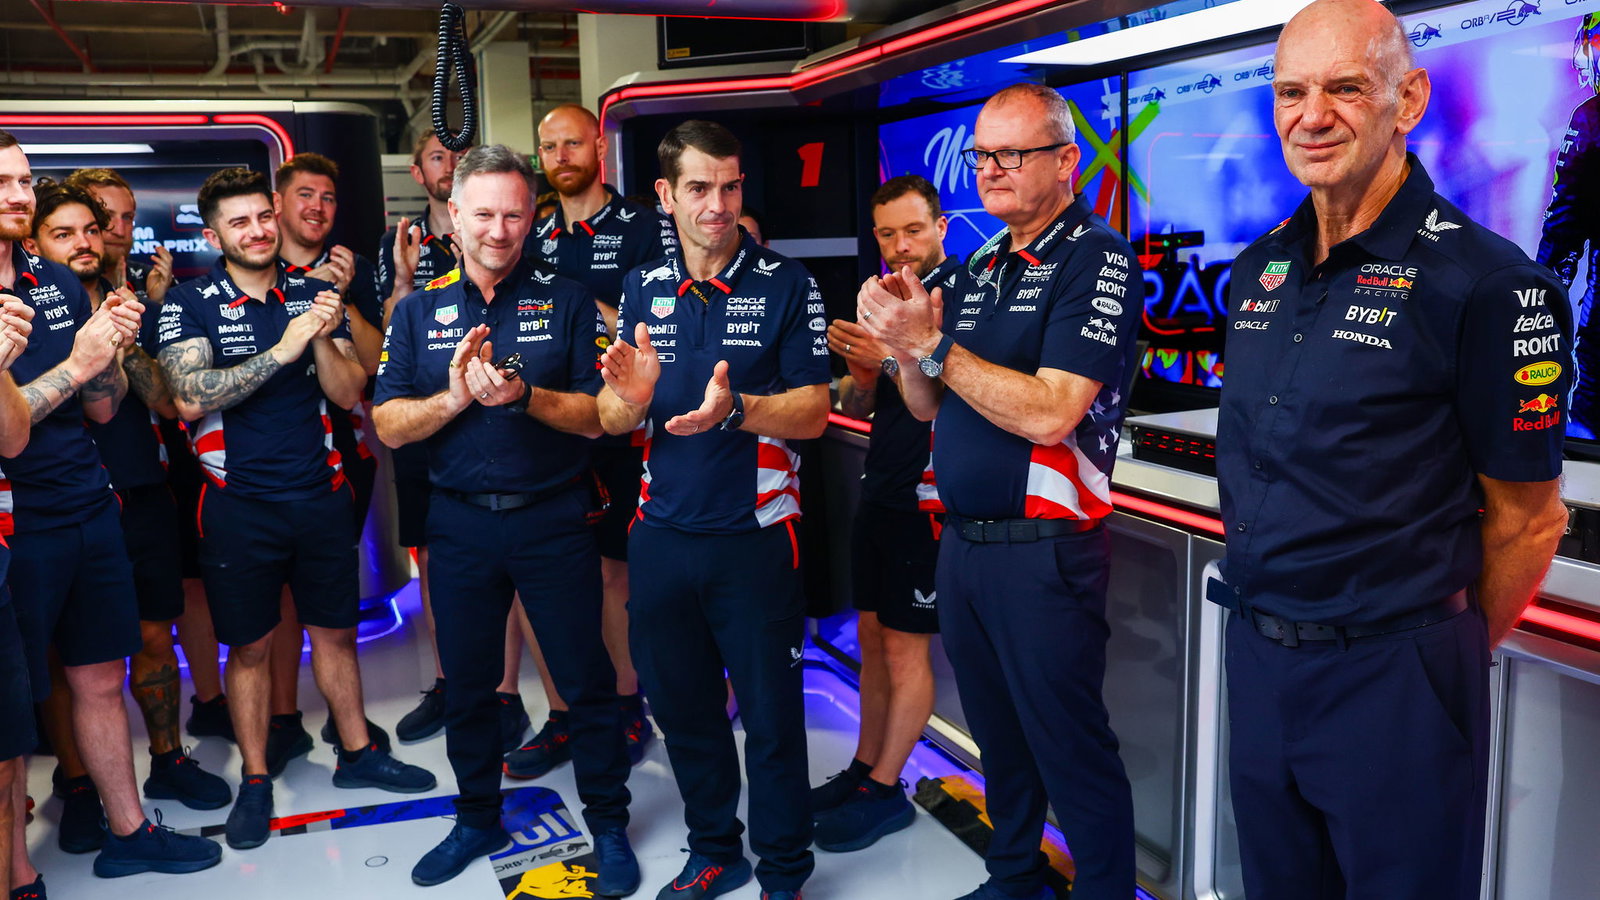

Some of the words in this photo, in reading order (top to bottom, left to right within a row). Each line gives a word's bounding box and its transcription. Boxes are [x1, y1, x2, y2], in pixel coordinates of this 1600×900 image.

[797, 142, 825, 188] 1
[1417, 228, 1440, 243] ASTORE
[164, 239, 209, 253] PRIX
[1102, 251, 1129, 269] VISA
[1098, 265, 1129, 282] telcel
[1271, 263, 1288, 273] KITH
[1360, 263, 1418, 278] ORACLE
[1357, 275, 1372, 285] Red
[1373, 276, 1389, 287] Bull
[1016, 286, 1043, 300] BYBIT
[1095, 279, 1127, 298] ROKT
[1354, 288, 1409, 300] RACING
[1101, 300, 1120, 313] RAUCH
[1240, 299, 1268, 313] Mobil
[1345, 305, 1397, 327] BYBIT
[218, 325, 244, 334] Mobil
[519, 318, 550, 332] BYBIT
[727, 320, 761, 334] BYBIT
[1234, 320, 1270, 330] ORACLE
[220, 335, 255, 344] ORACLE
[428, 329, 453, 339] Mobil
[516, 334, 553, 343] HONDA
[1080, 326, 1101, 341] Red
[1101, 332, 1117, 346] Bull
[1331, 329, 1393, 350] HONDA
[428, 342, 459, 350] ORACL
[650, 339, 677, 347] RACLE
[722, 339, 762, 347] HONDA
[1513, 333, 1561, 357] ROKT
[1529, 365, 1557, 380] RAUCH
[1513, 416, 1544, 432] Red
